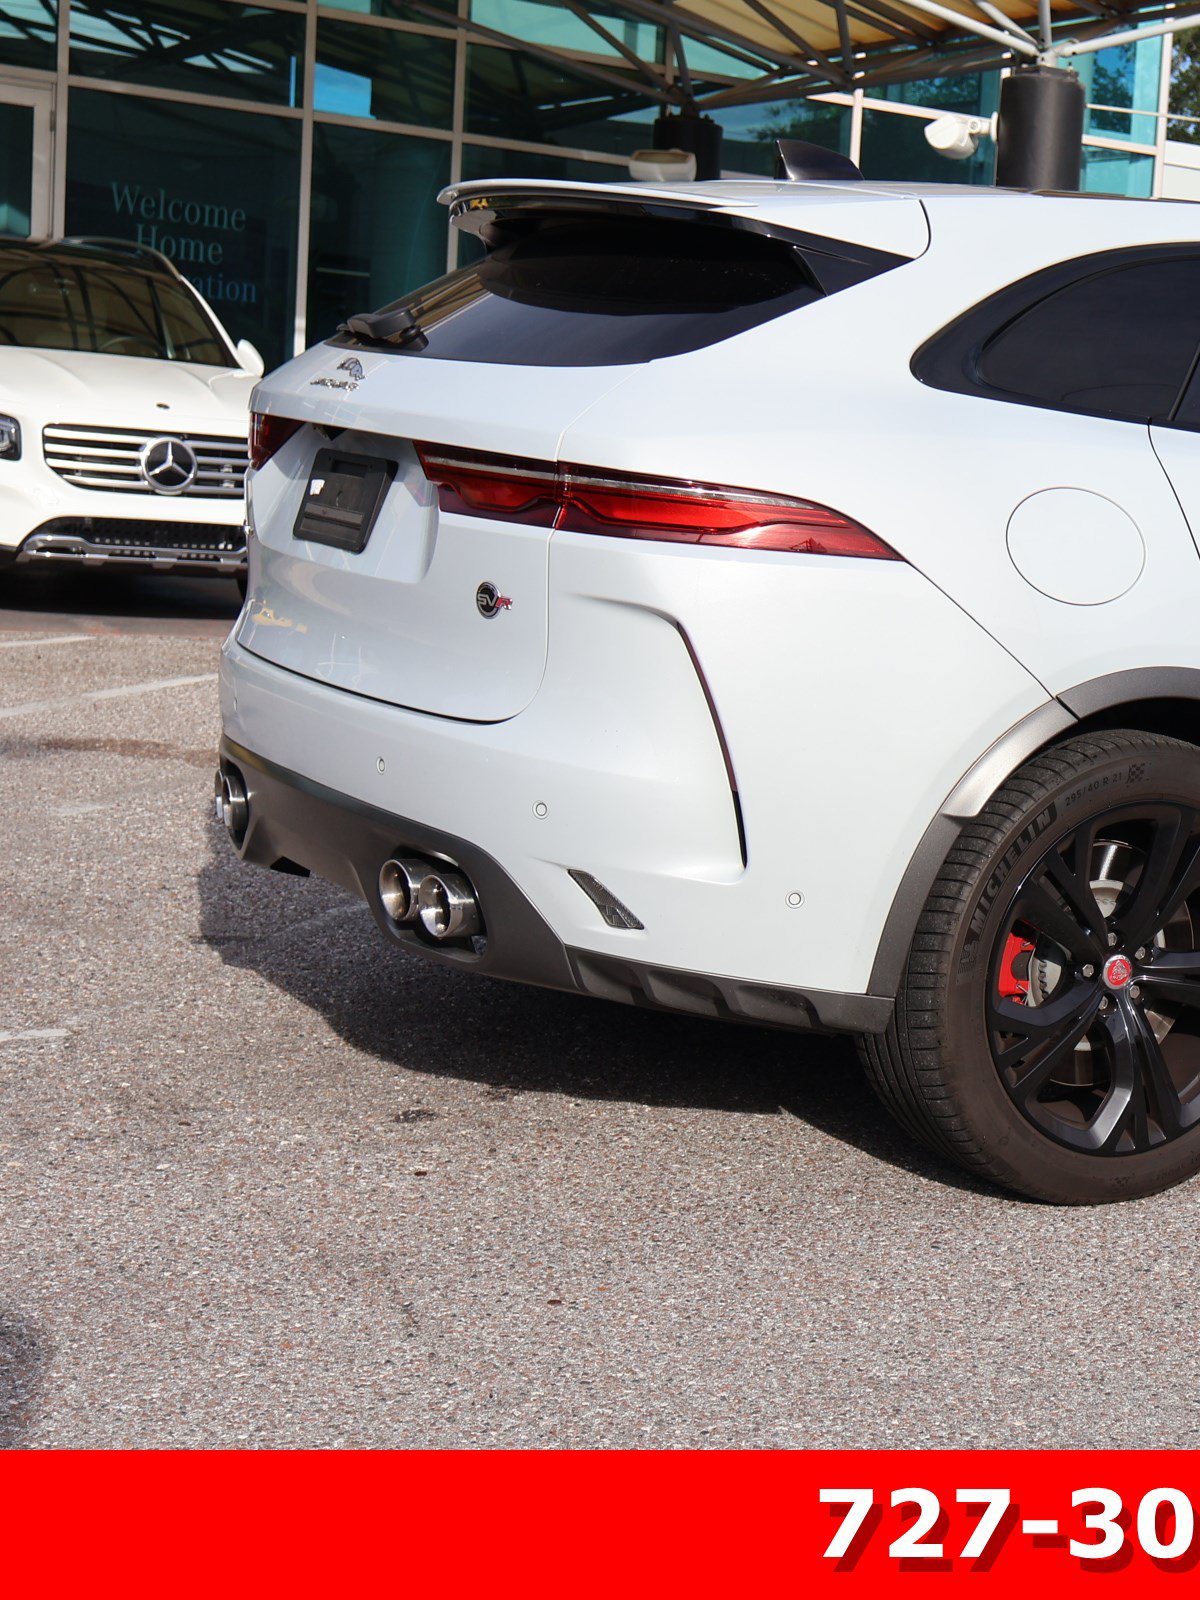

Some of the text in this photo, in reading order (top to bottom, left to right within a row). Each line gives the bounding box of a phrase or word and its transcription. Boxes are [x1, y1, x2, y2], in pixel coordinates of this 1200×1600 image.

[111, 181, 247, 232] Welcome
[136, 223, 224, 265] Home
[969, 807, 1051, 934] MICHELIN
